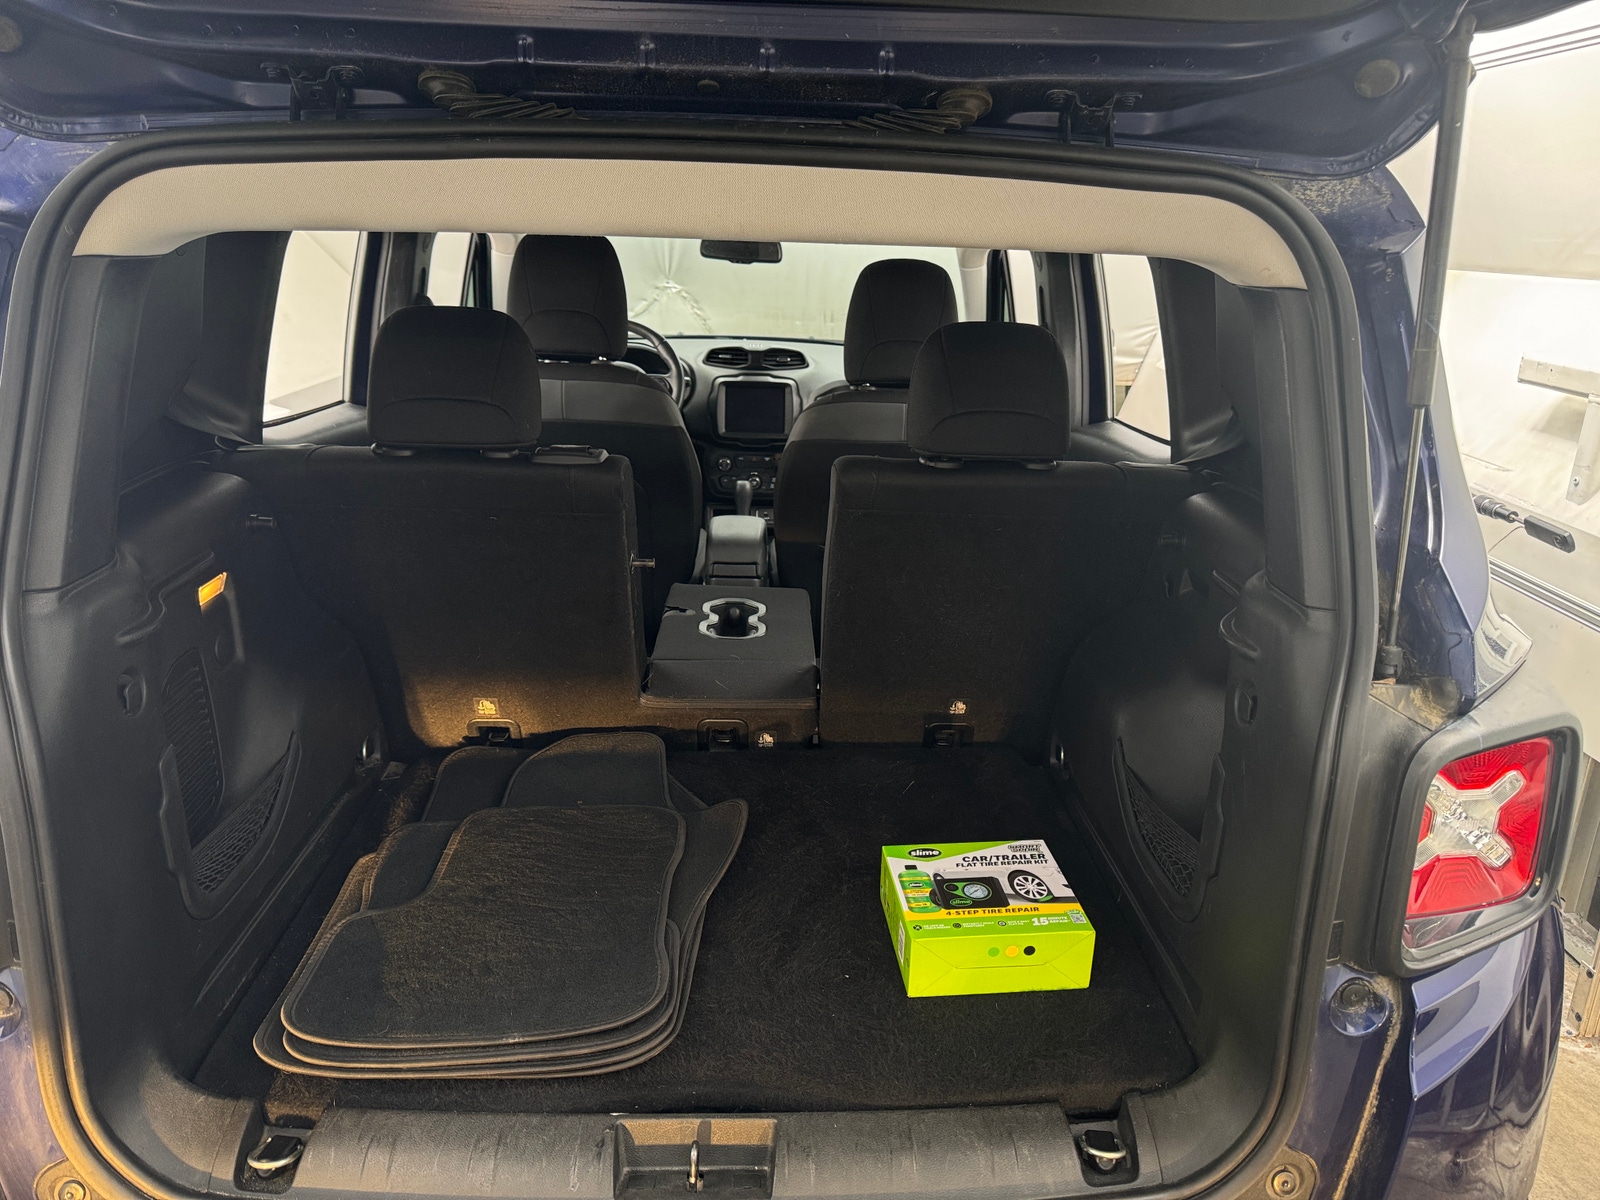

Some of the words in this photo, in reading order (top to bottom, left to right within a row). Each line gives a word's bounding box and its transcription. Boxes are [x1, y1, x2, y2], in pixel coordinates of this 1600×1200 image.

[910, 849, 940, 857] slime
[962, 854, 1046, 862] CAR/TRAILER
[1005, 906, 1040, 914] REPAIR
[1031, 916, 1049, 926] 15
